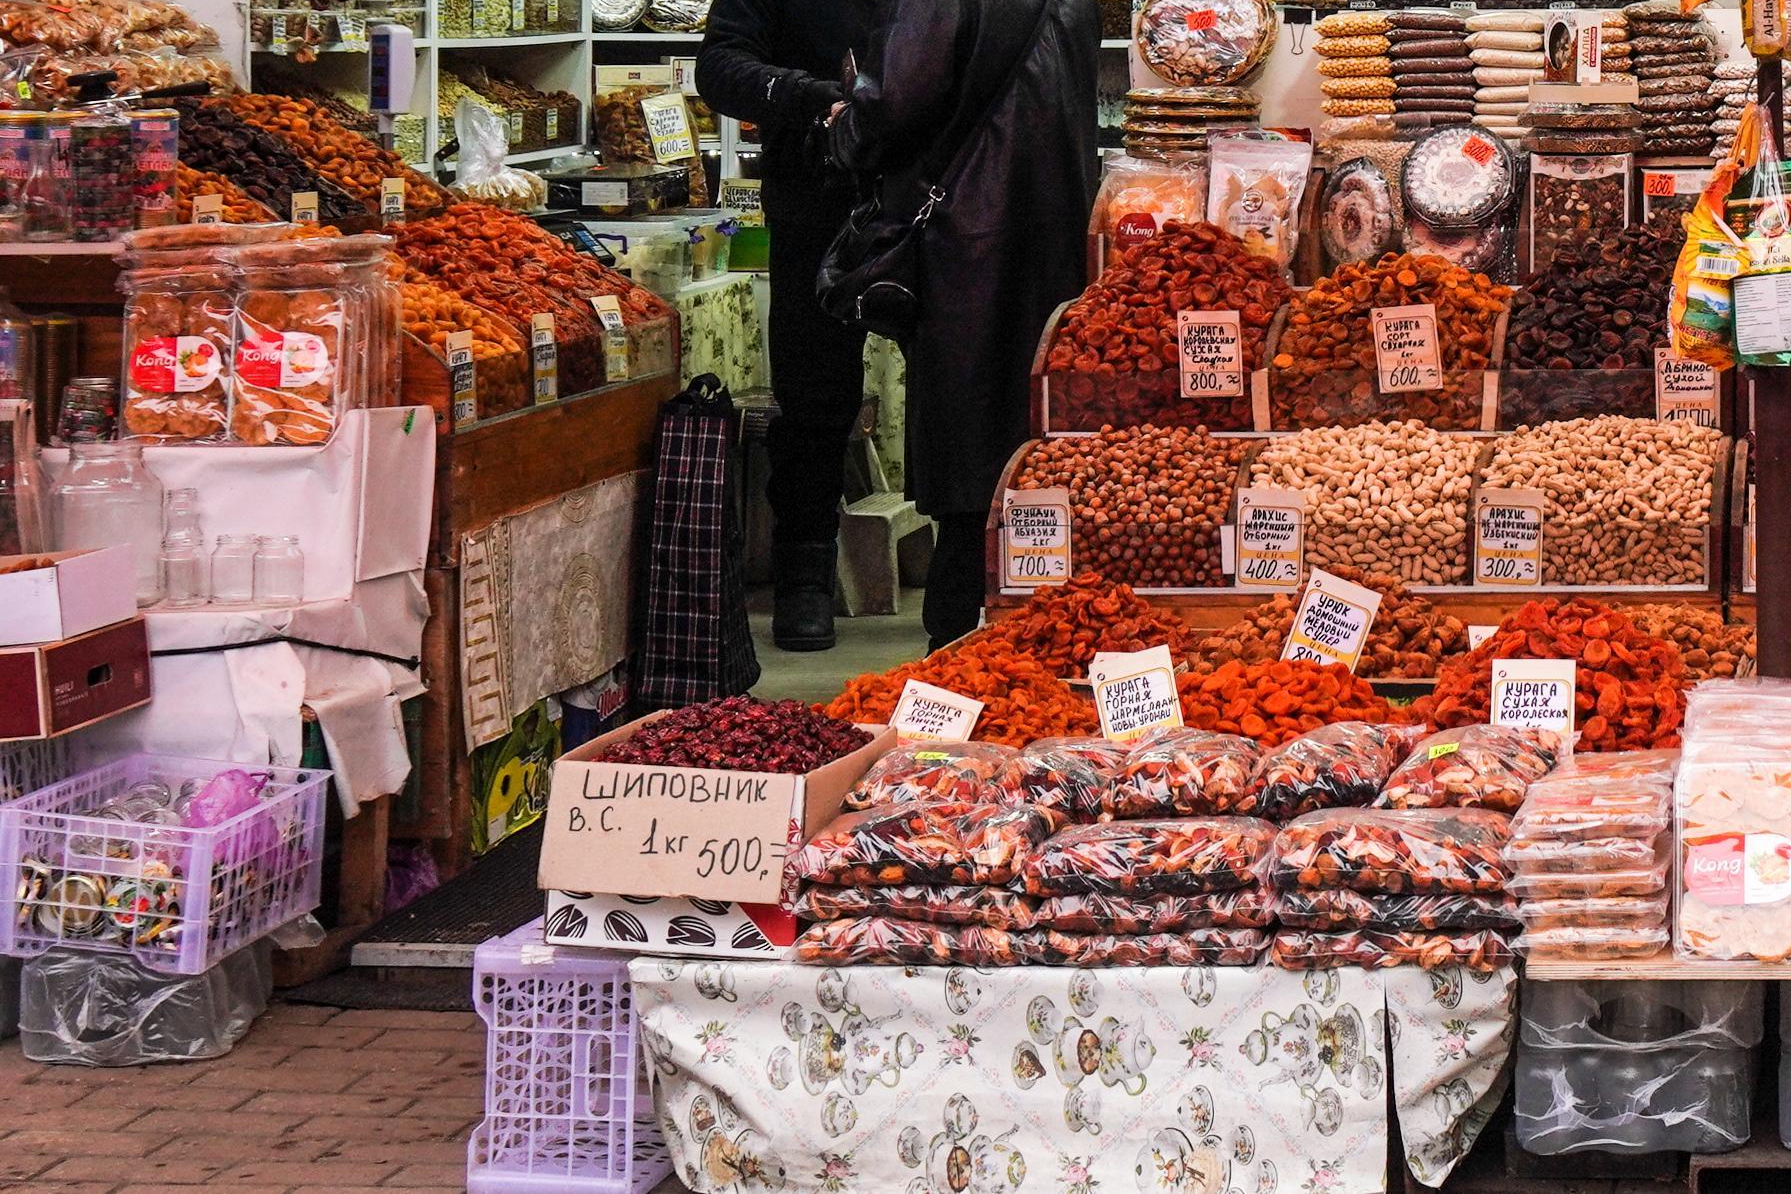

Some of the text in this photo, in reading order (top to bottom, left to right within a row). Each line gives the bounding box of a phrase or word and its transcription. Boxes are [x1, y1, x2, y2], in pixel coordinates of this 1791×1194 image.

[1582, 27, 1590, 66] ХАЛВА
[1124, 222, 1155, 237] Kong
[1187, 325, 1225, 336] КУРАГА
[1384, 320, 1420, 333] КУРАГА
[135, 354, 174, 368] Kong
[242, 349, 280, 364] Kong
[1664, 360, 1712, 373] АБРИКОС
[1011, 508, 1056, 518] ФУНДУК
[1251, 508, 1288, 522] АРАХИС
[1489, 507, 1526, 520] АРАХИС
[1014, 527, 1057, 537] АБХАЗИЯ
[1317, 594, 1351, 617] УРЮК
[1304, 626, 1340, 647] СУПЕР
[1106, 676, 1150, 699] КУРАГА
[1505, 681, 1558, 697] КУРАГА
[912, 698, 962, 718] КУРАГА
[1105, 690, 1152, 711] ГОРНАЯ
[1502, 696, 1551, 709] СУХАЯ
[911, 708, 953, 724] ГОРНАЯ
[582, 768, 769, 804] ШИПОВНИК
[1692, 856, 1742, 875] Kong
